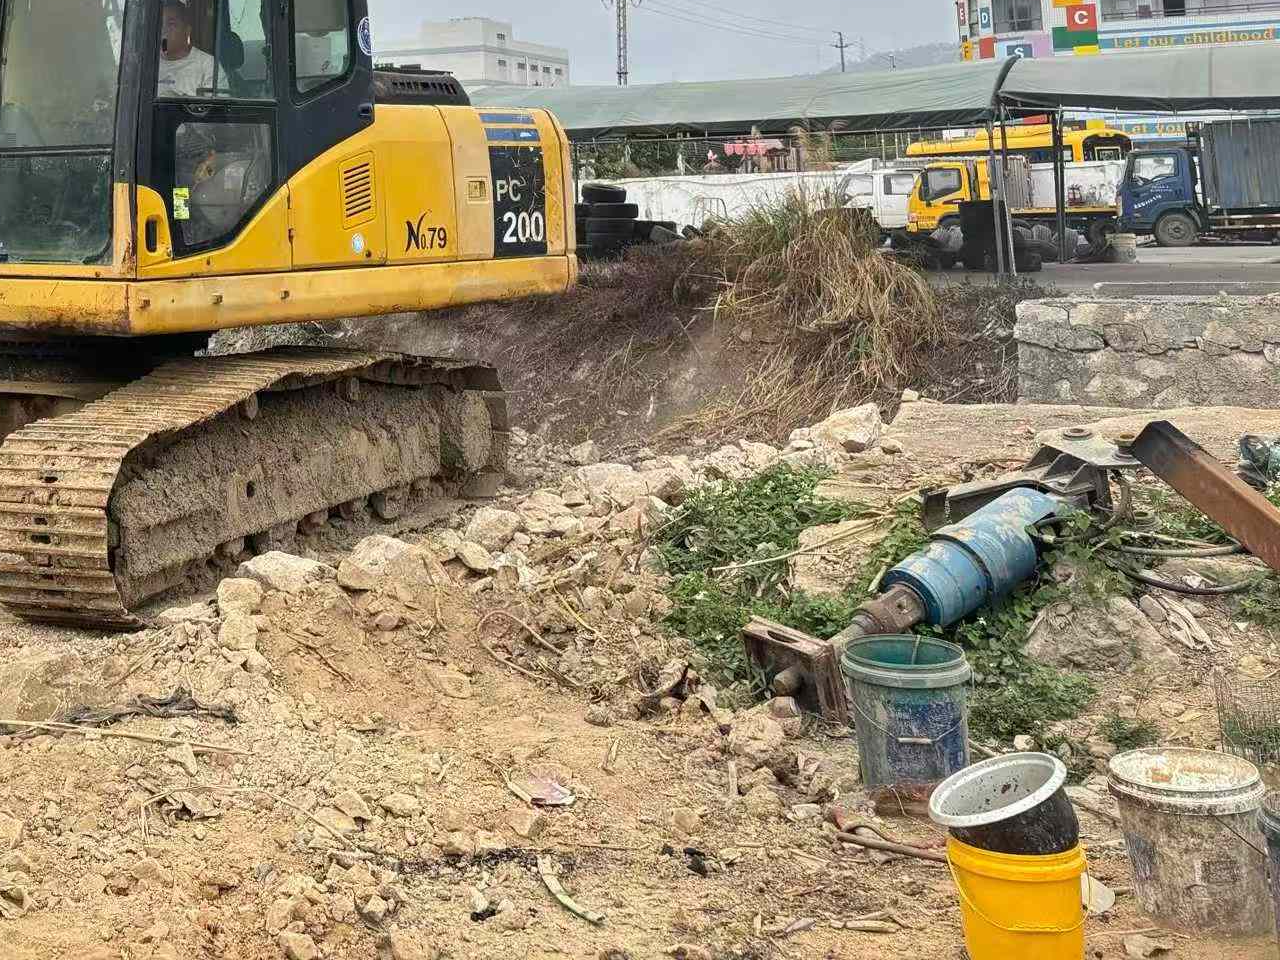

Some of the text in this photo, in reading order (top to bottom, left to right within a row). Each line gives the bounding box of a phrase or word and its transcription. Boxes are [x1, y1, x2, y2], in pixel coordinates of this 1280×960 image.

[981, 12, 988, 24] D
[1073, 10, 1089, 25] C
[1184, 27, 1276, 44] childhood
[496, 179, 523, 203] PC
[502, 211, 545, 244] 200
